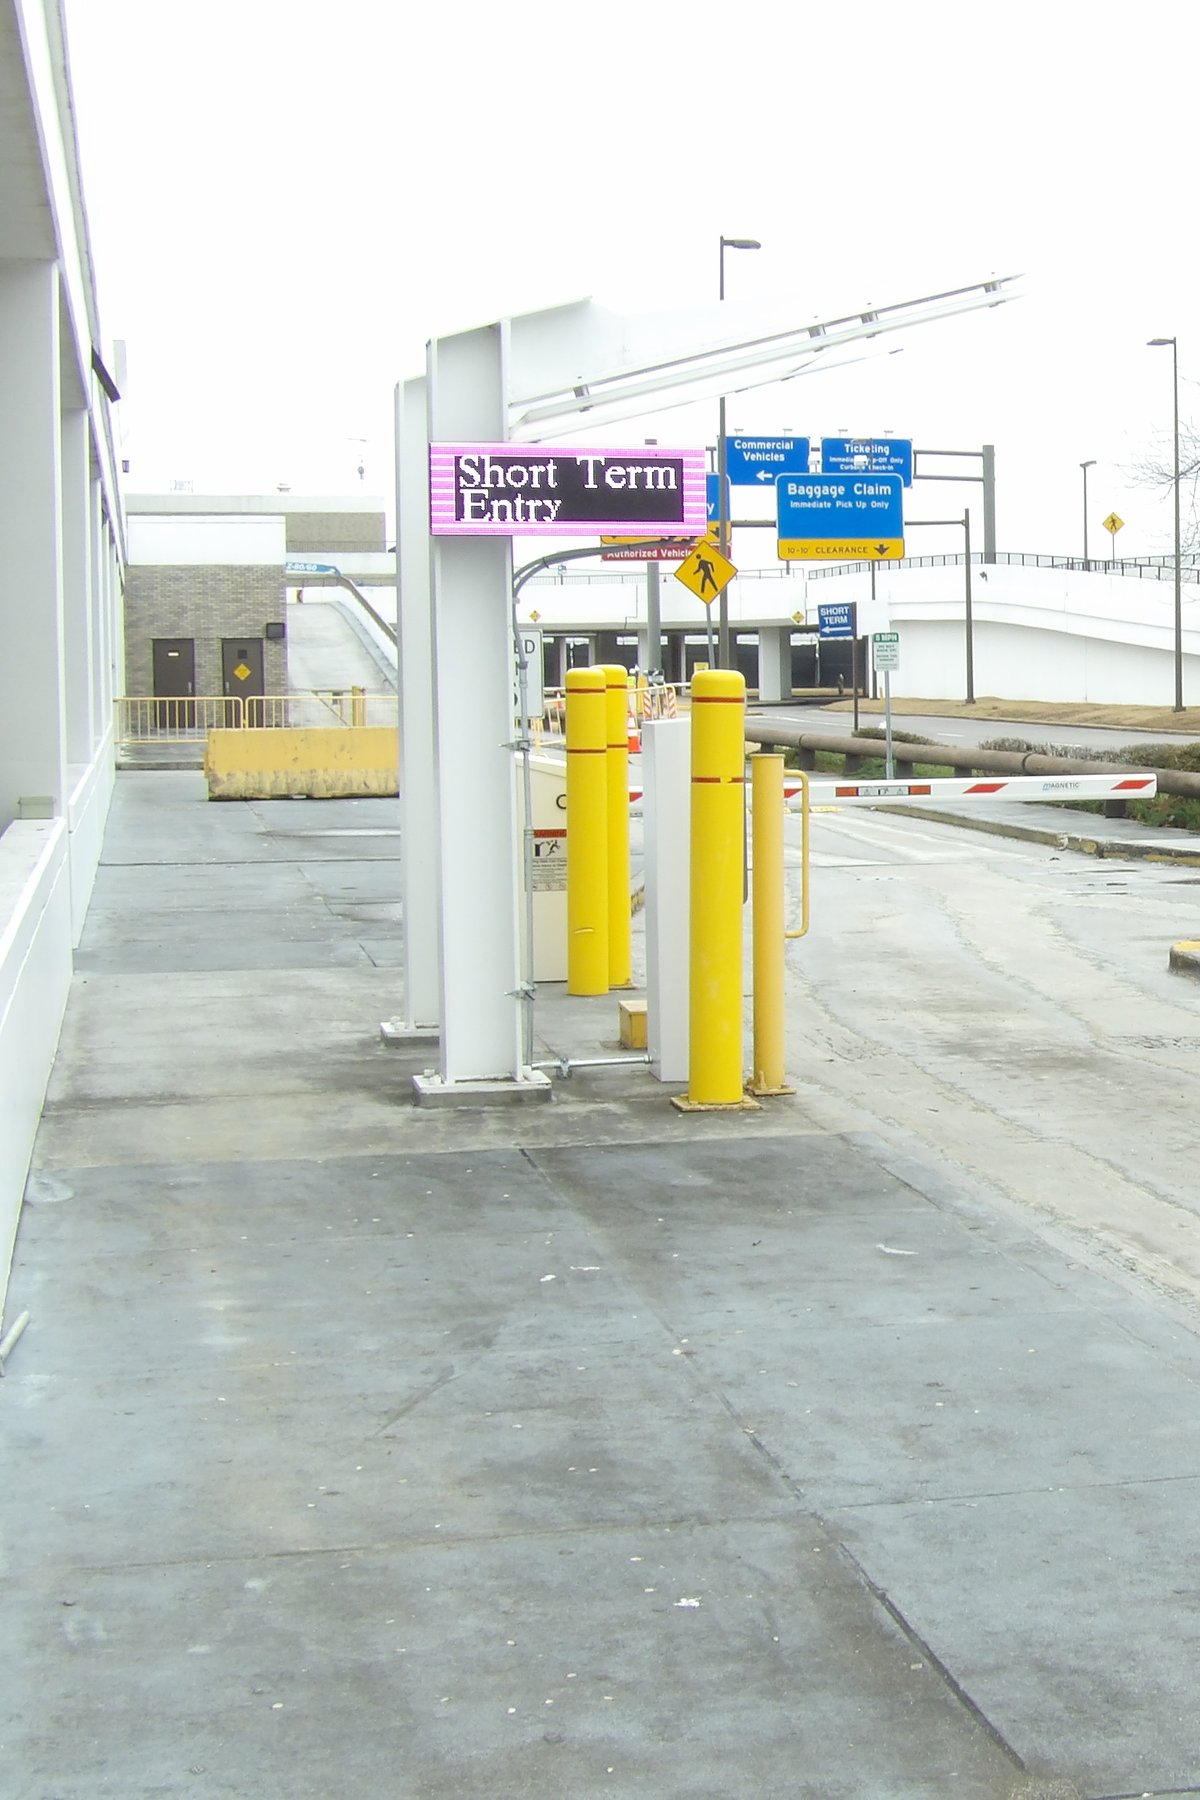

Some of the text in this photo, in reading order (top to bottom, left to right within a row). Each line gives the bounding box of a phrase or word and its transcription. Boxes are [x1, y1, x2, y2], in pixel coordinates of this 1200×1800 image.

[734, 439, 794, 450] Commercial
[743, 451, 785, 462] Vehicles
[890, 456, 904, 464] Only
[459, 454, 678, 490] Short Term
[787, 483, 892, 499] Baggage Claim
[459, 489, 563, 522] Entry
[790, 500, 889, 510] Immediate Pick Up Only
[815, 546, 868, 554] CLEARANCE
[820, 606, 850, 616] SHORT
[824, 616, 848, 625] TERM
